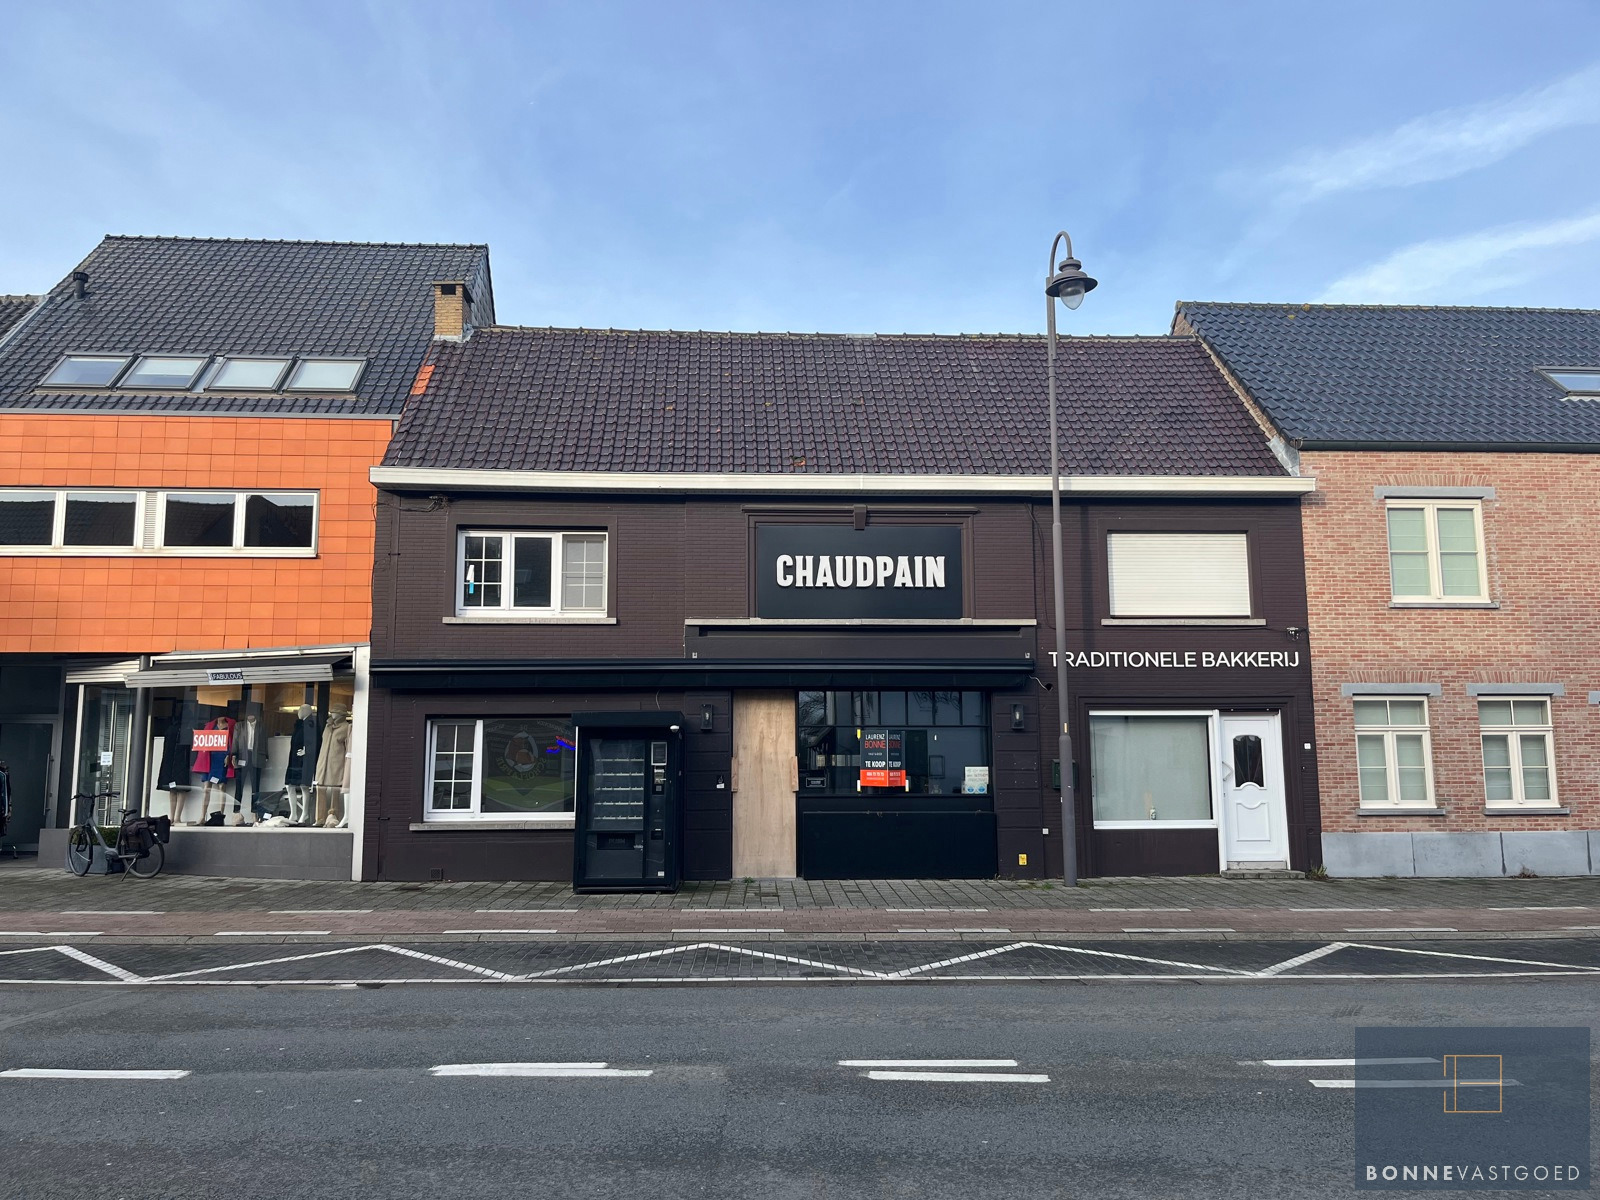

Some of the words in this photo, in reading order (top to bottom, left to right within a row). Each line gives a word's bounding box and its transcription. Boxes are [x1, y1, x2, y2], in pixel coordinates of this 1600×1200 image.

[776, 554, 946, 588] CHAUDPAIN
[1048, 651, 1197, 668] TRADITIONELE
[1202, 651, 1299, 668] BAKKERIJ
[193, 734, 227, 747] SOLDEN!
[865, 740, 886, 749] BONNE
[865, 760, 872, 768] TE
[872, 760, 885, 768] KOOP
